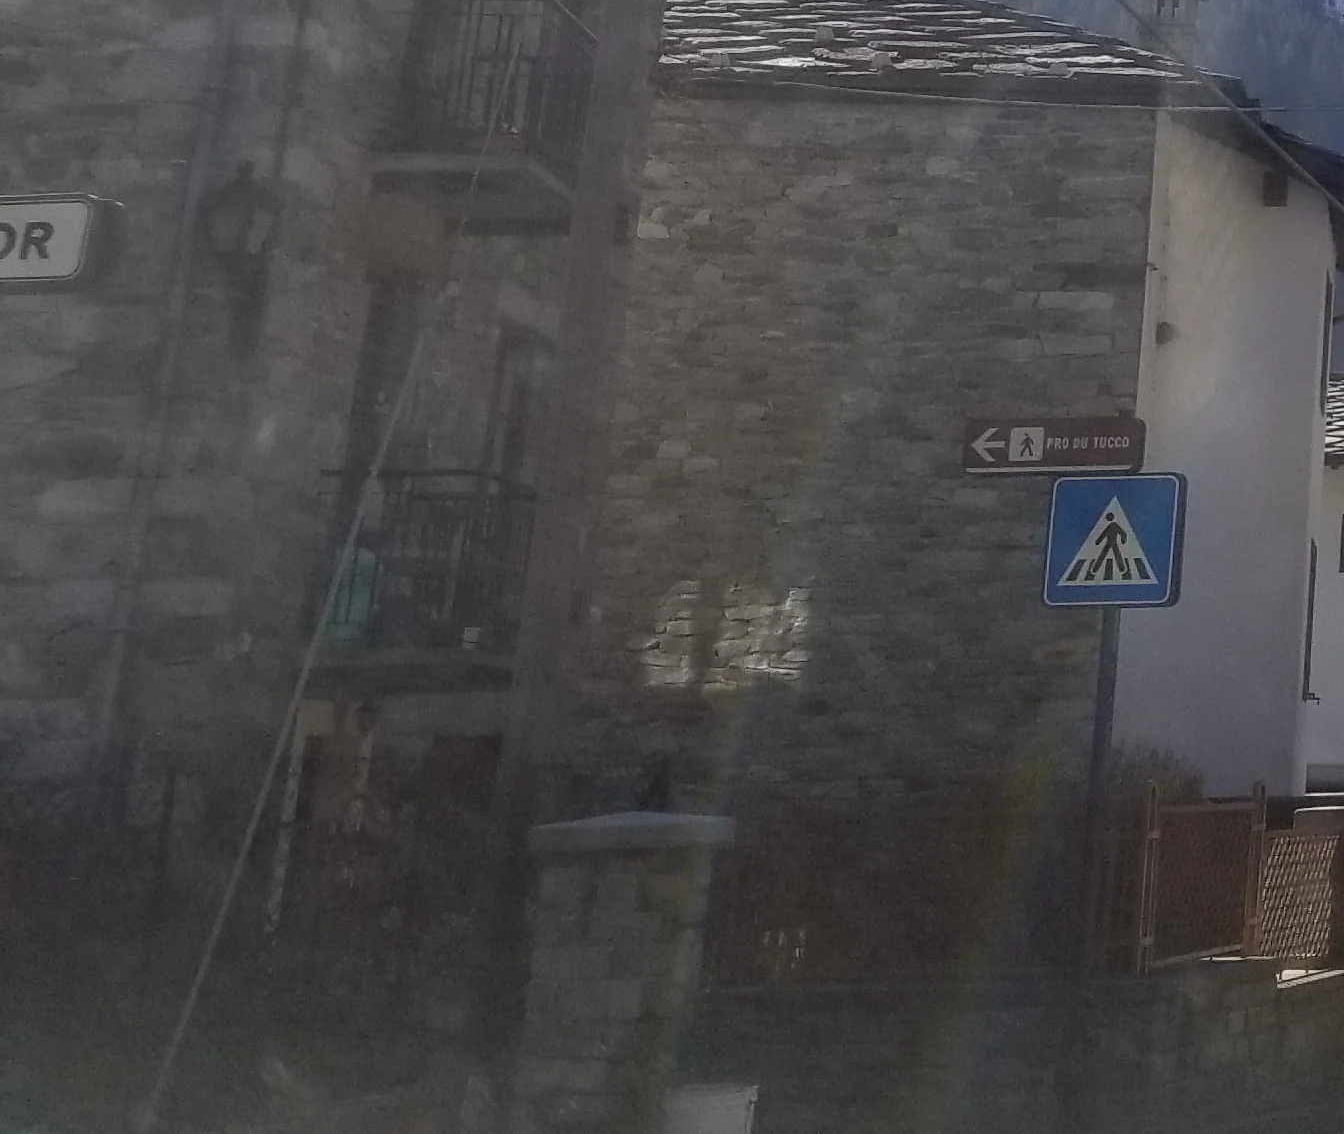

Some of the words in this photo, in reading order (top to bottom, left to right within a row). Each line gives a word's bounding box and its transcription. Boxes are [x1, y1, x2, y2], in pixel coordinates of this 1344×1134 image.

[1046, 436, 1069, 450] PRO
[1072, 436, 1089, 449] DU
[1092, 435, 1130, 449] TUCCO
